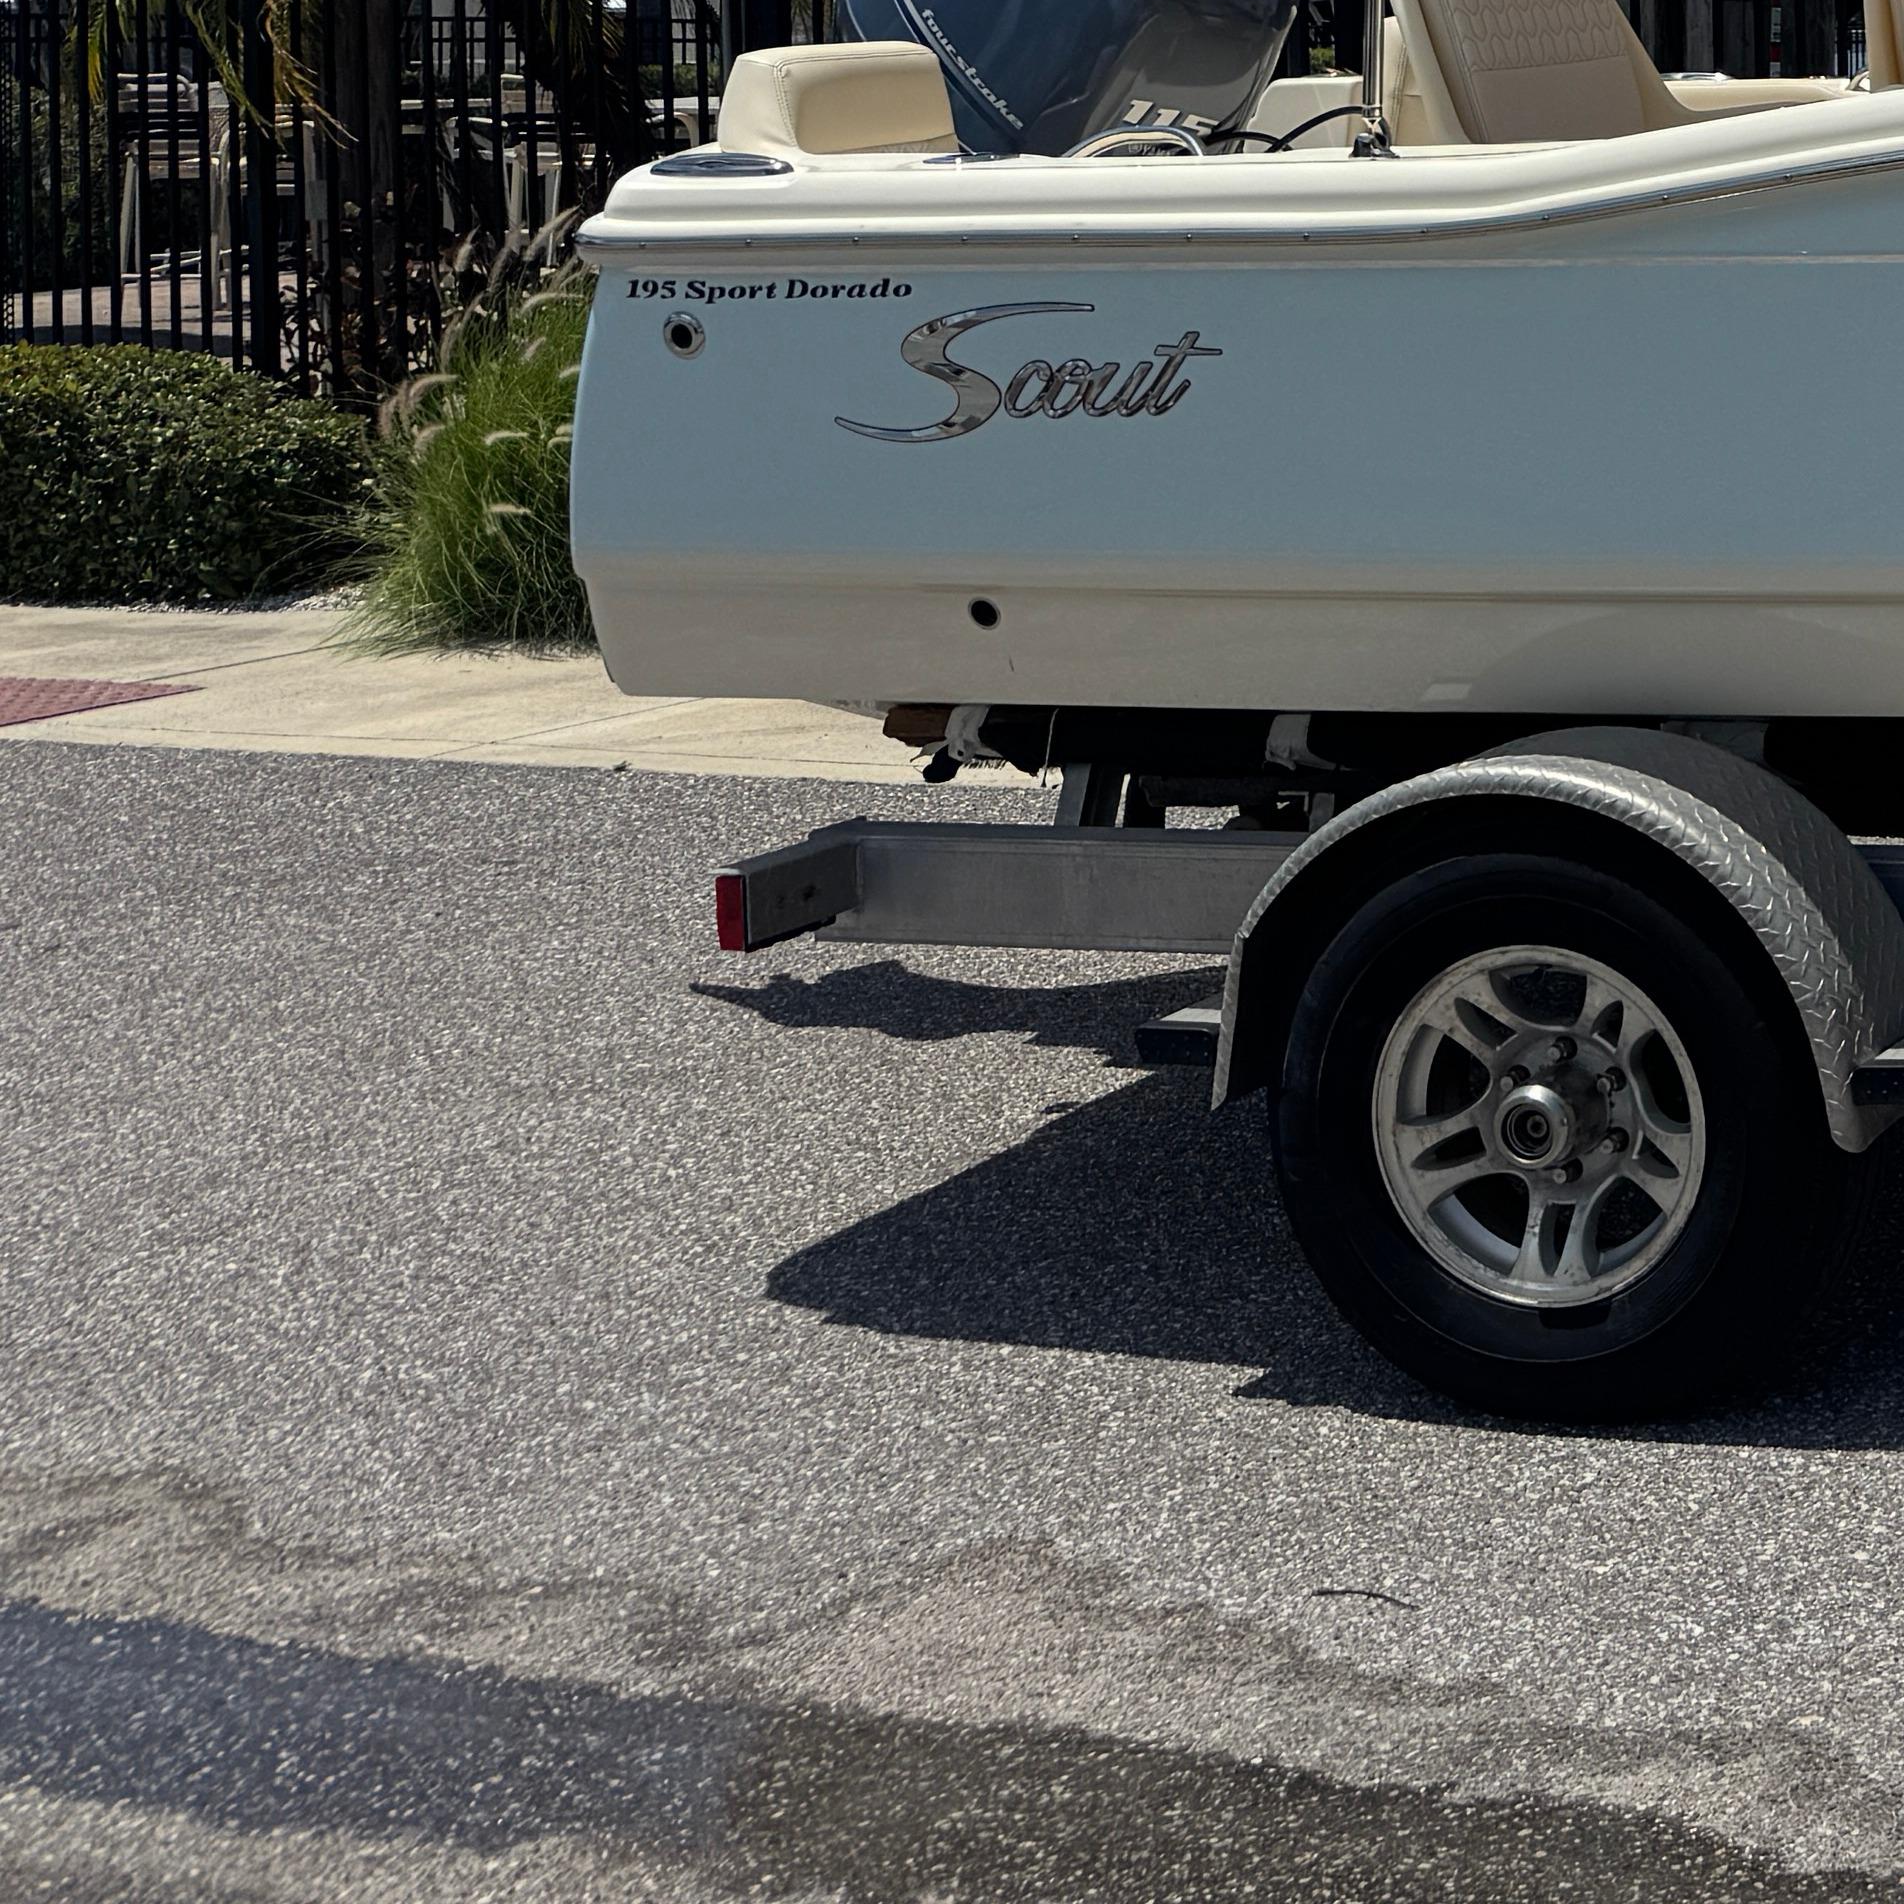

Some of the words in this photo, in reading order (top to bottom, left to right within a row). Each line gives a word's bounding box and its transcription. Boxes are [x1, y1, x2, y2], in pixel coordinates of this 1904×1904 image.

[1122, 99, 1220, 137] 115
[625, 279, 677, 300] 195
[684, 280, 777, 305] Sport
[784, 278, 913, 299] Dorado
[834, 301, 1223, 443] Scout
